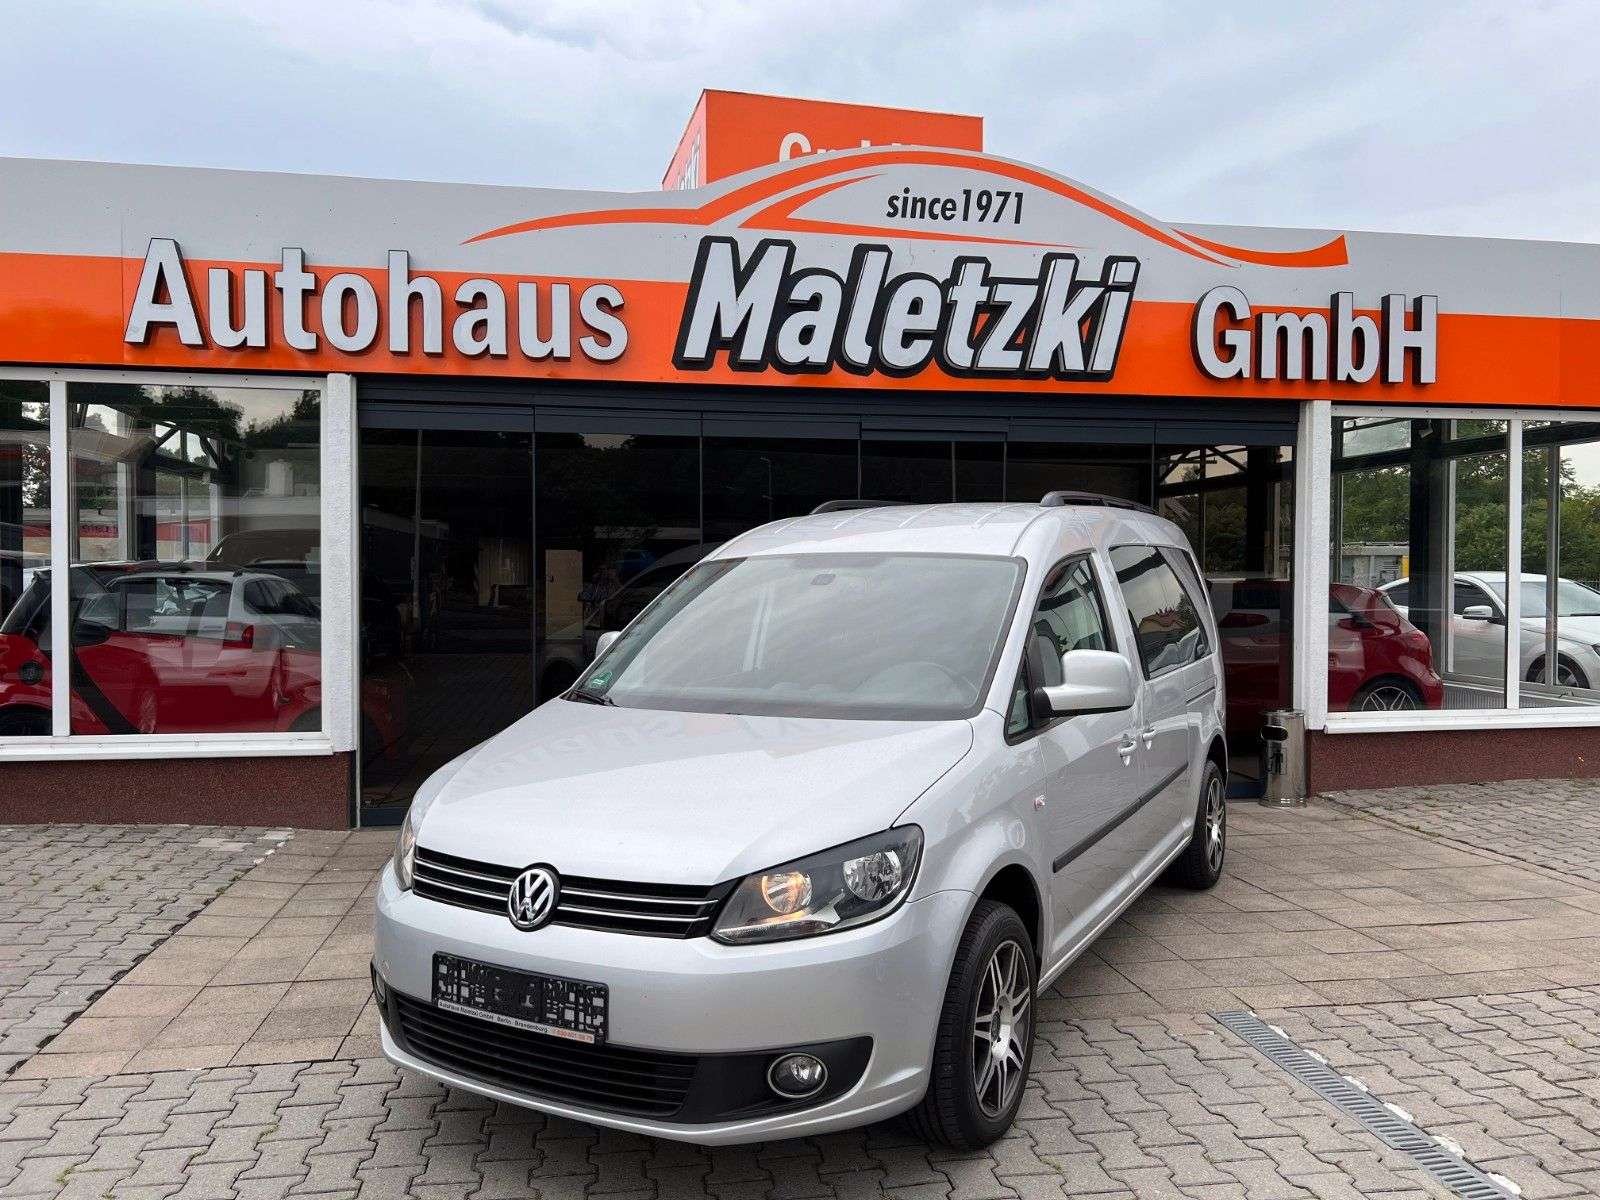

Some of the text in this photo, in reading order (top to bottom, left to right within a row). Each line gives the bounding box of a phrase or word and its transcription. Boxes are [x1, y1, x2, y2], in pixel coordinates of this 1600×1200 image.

[123, 235, 1439, 385] Autohaus Maletzki GmbH
